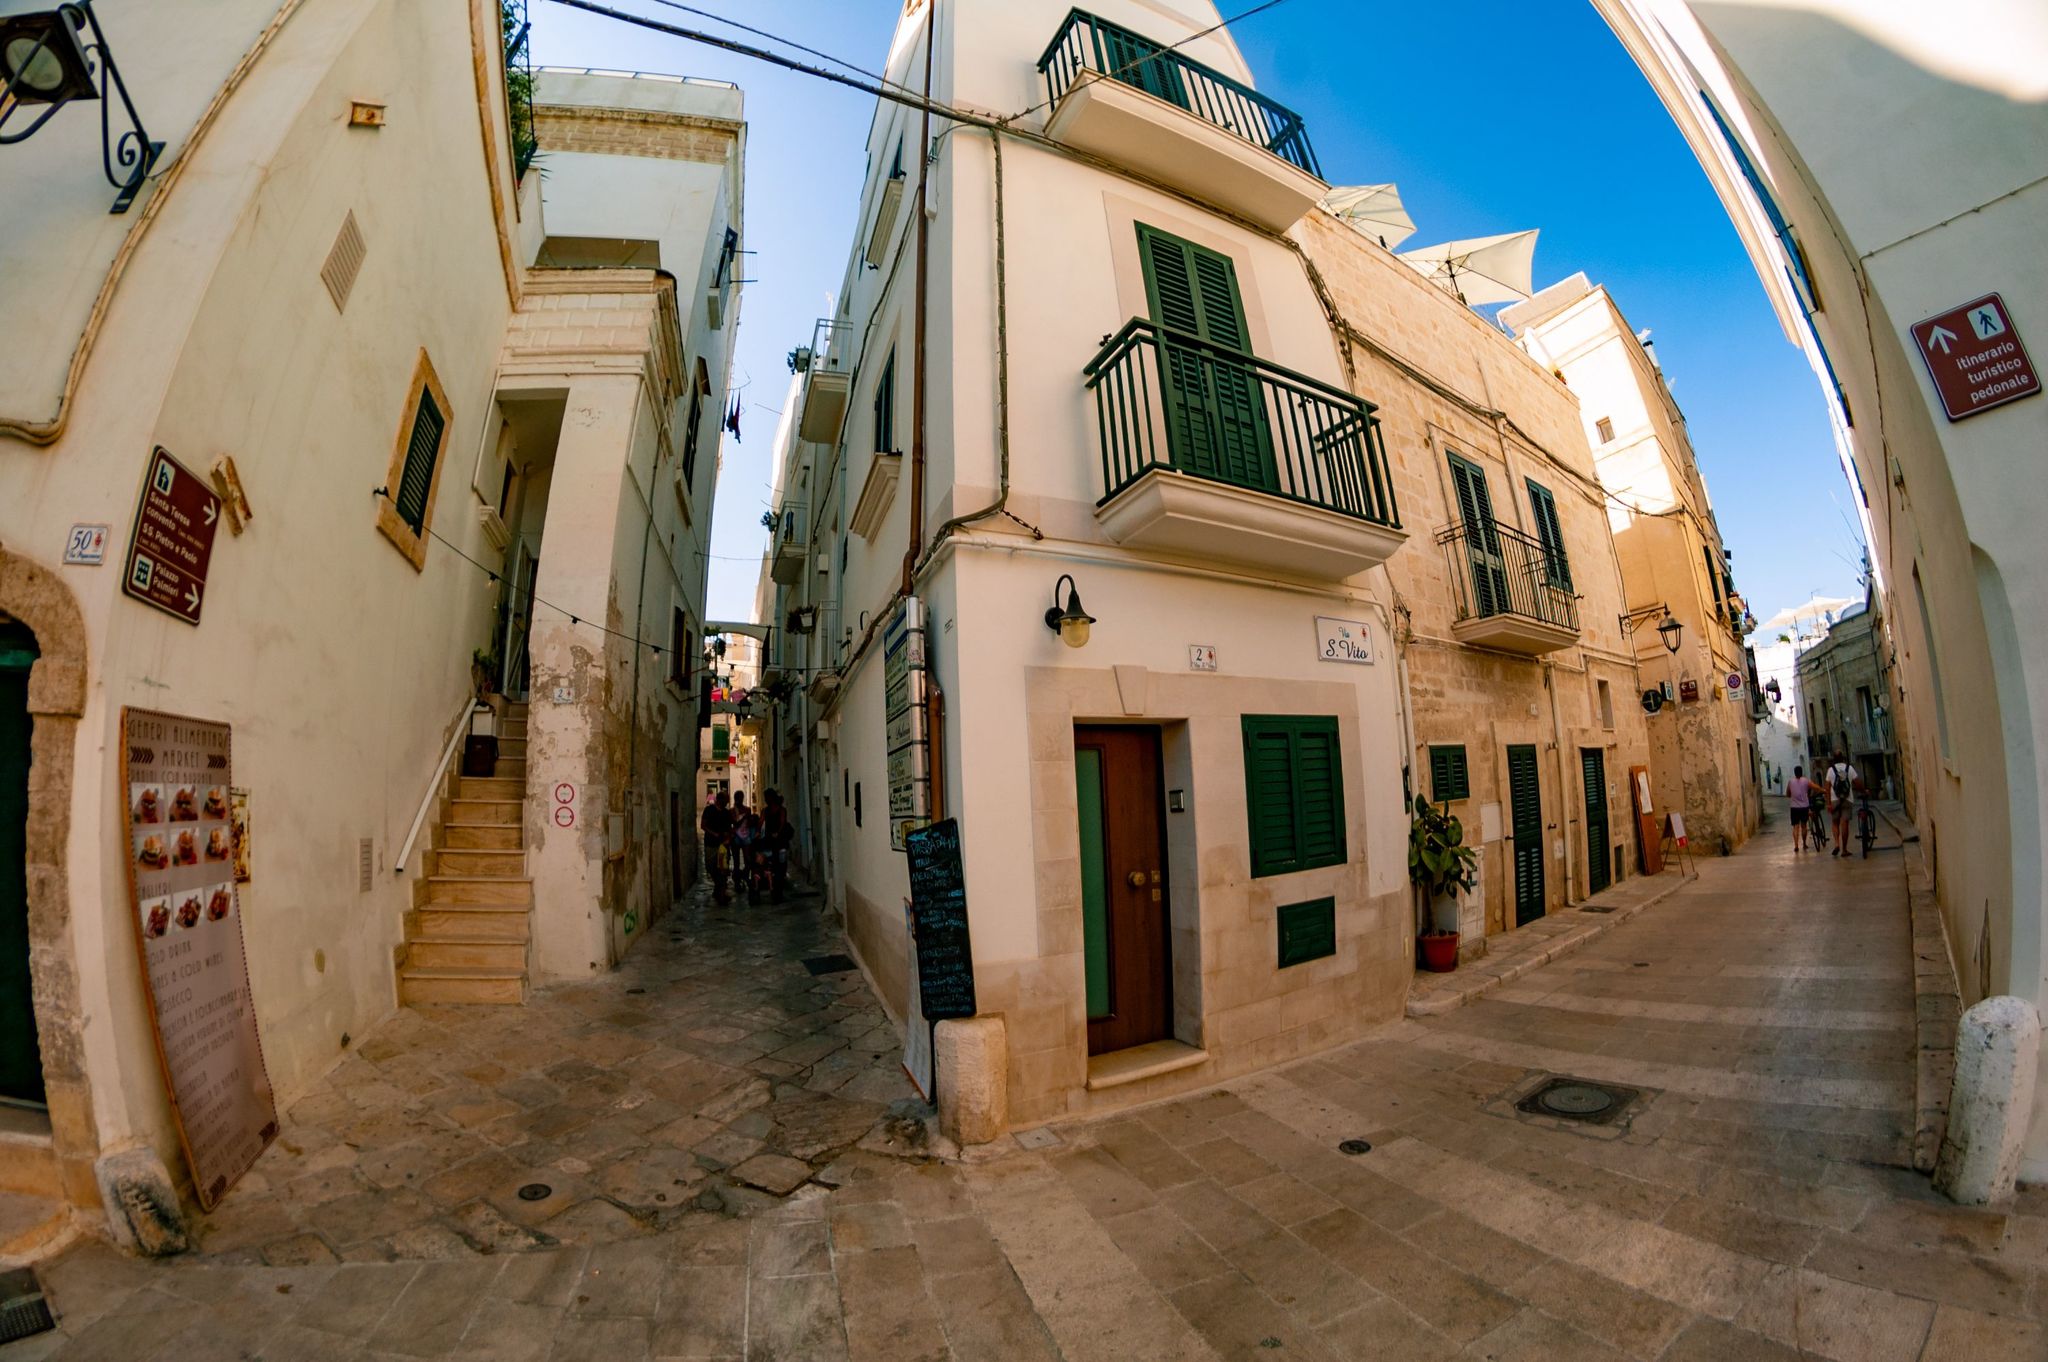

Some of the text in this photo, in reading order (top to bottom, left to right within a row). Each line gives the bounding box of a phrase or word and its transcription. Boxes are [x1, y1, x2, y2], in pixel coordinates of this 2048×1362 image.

[1956, 342, 2015, 370] itinerario
[1968, 358, 2022, 384] turistico
[1970, 374, 2029, 404] pedonale
[146, 506, 176, 531] convento
[72, 530, 92, 550] 50
[155, 530, 174, 550] Pietro
[180, 547, 198, 565] Paolo
[155, 562, 179, 583] Palazzo
[153, 576, 179, 597] Palmieri
[1196, 648, 1203, 661] 2
[1325, 638, 1369, 659] S. Vito
[162, 749, 199, 769] MARKET
